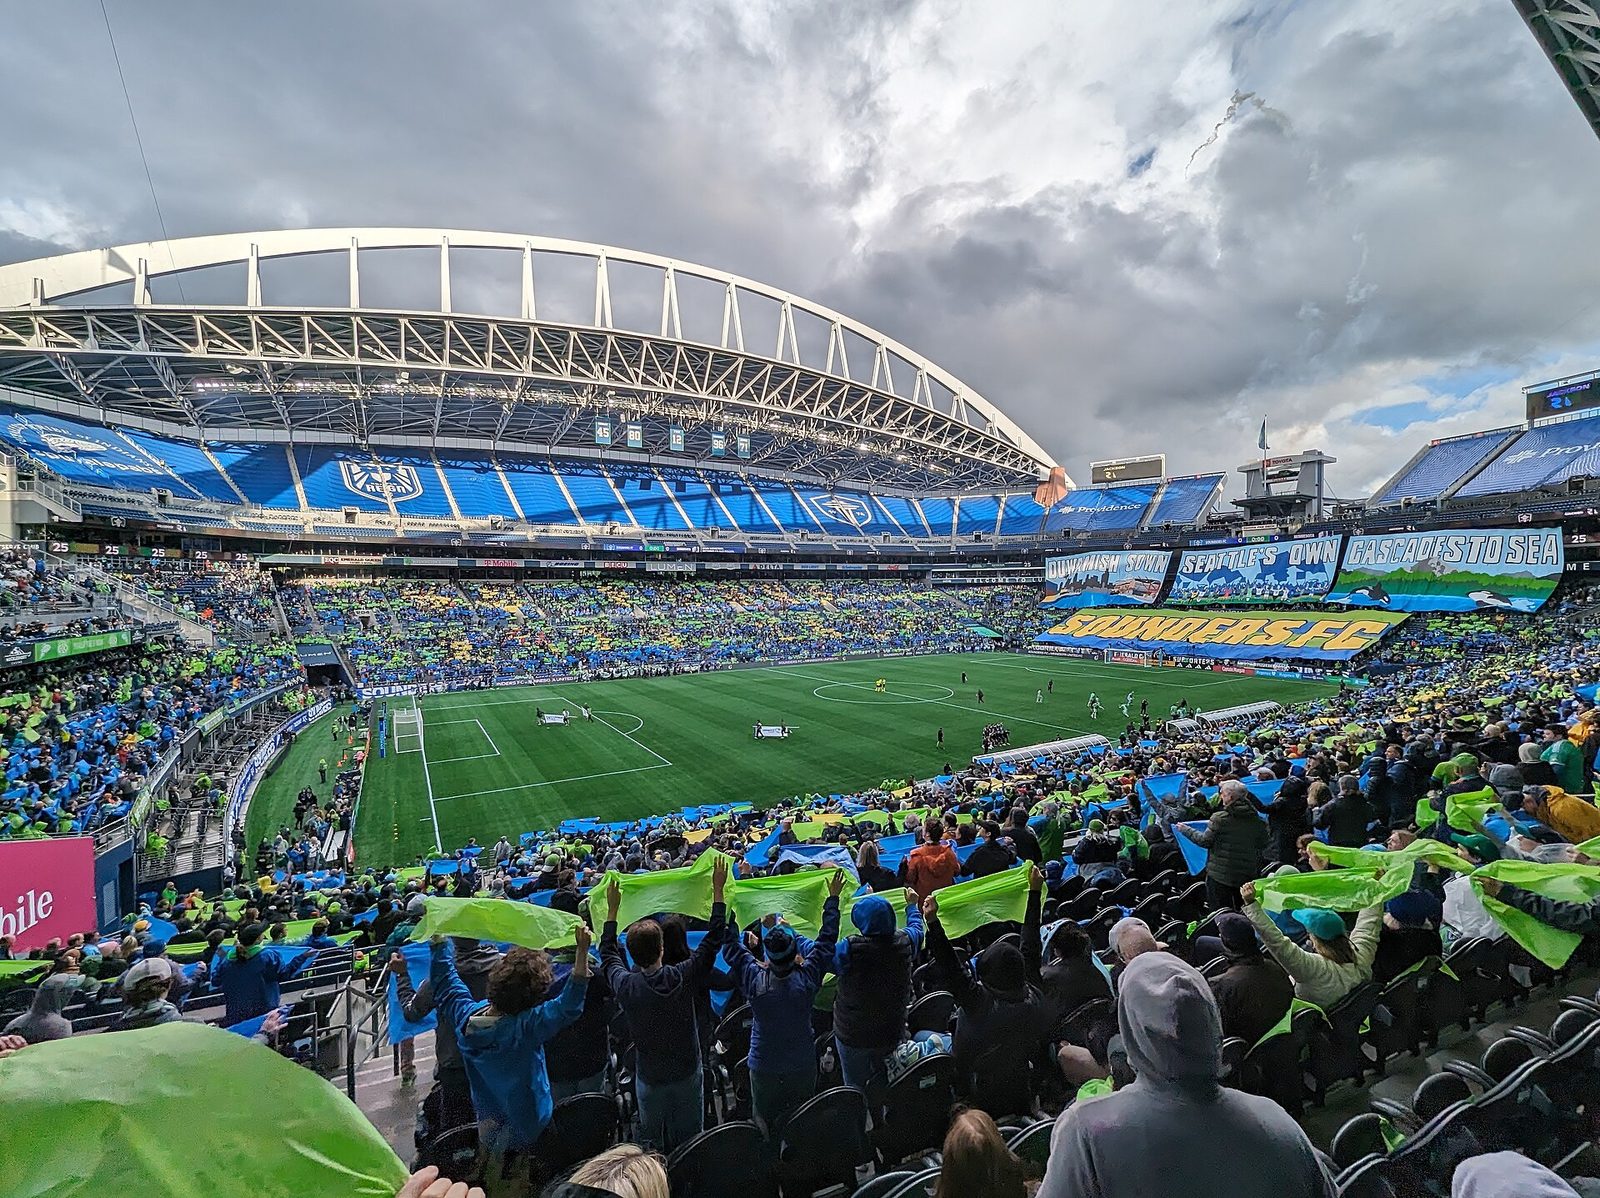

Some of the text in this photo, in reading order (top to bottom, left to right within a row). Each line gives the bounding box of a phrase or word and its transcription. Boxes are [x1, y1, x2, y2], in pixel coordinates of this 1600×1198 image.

[596, 427, 610, 438] 45
[627, 430, 641, 441] 80
[671, 434, 682, 445] 12
[712, 439, 724, 450] 96
[738, 442, 749, 453] 71
[1271, 457, 1293, 465] TOYOTA
[365, 484, 407, 494] REGN
[1077, 503, 1142, 513] Providence
[1571, 534, 1587, 544] 25
[52, 542, 69, 552] 25
[105, 545, 120, 555] 25
[1505, 533, 1559, 565] SEA
[151, 548, 166, 557] 25
[195, 551, 208, 559] 25
[235, 553, 248, 561] 25
[1182, 538, 1339, 574] SEATTLE'S OWN
[650, 563, 693, 571] LUMEN
[1047, 553, 1121, 580] DUWAMISH
[1048, 614, 1391, 651] SOUNDERS FC
